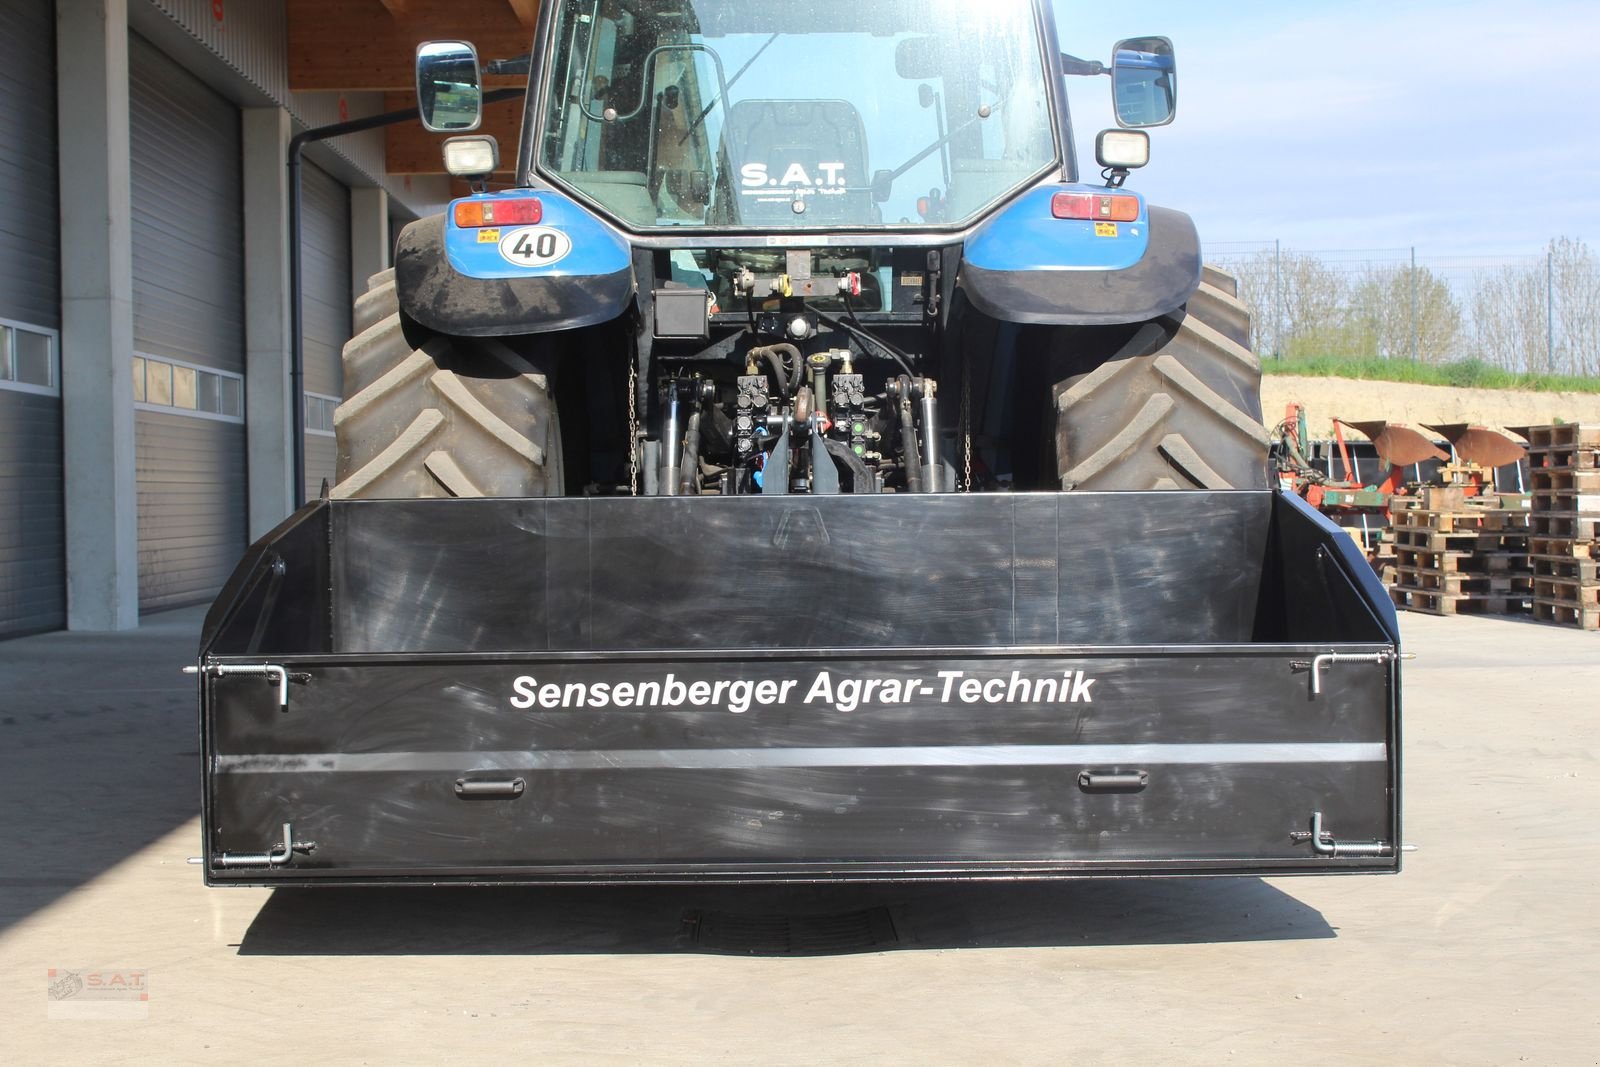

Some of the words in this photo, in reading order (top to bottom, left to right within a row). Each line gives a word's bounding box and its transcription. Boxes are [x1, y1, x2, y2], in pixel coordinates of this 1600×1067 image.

[741, 162, 846, 187] S.A.T.
[512, 233, 557, 258] 40
[509, 674, 798, 713] Sensenberger
[803, 670, 1096, 712] Agrar-Technik
